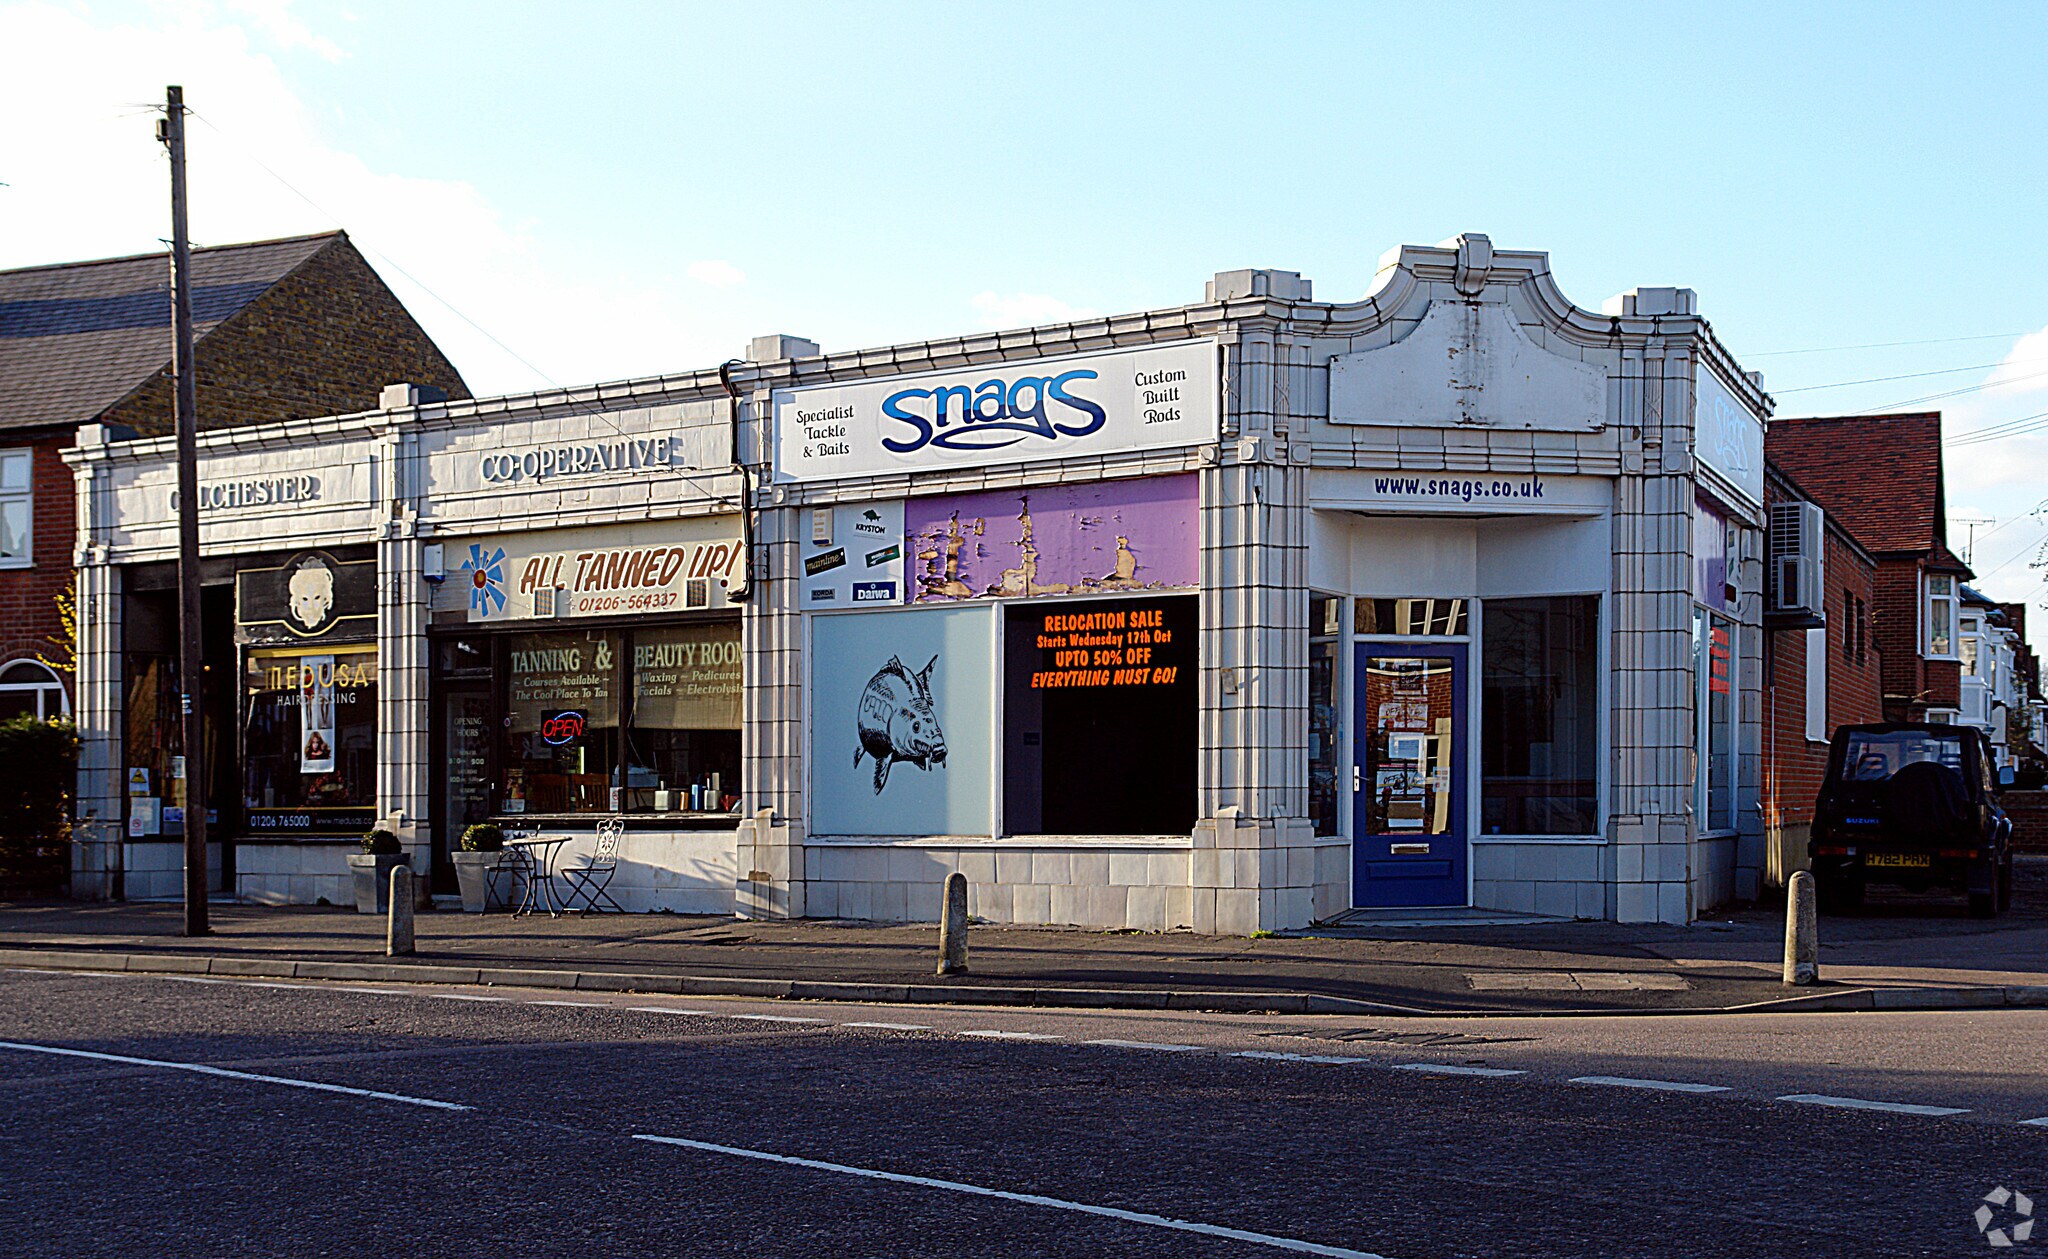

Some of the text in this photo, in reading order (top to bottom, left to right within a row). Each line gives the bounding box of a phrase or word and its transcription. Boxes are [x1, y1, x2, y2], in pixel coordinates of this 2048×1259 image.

[1135, 369, 1187, 387] Custom
[1142, 387, 1180, 405] Built
[796, 404, 854, 426] Specialist
[1143, 407, 1181, 424] Rods
[803, 424, 846, 440] Tackle
[479, 437, 672, 481] CO-OPERATIVE
[803, 442, 850, 458] & Baits
[169, 475, 313, 511] CLCHESTER
[1375, 475, 1544, 503] www.snags.co.uk
[855, 523, 886, 534] KRYSTON
[519, 538, 744, 596] ALL TANNED UP!
[579, 592, 678, 612] 01206-564337
[857, 588, 890, 600] Daiwa
[1044, 610, 1163, 632] RELOCATION SALE
[1036, 629, 1172, 648] Starts Wednesday 17th Oct
[511, 640, 613, 673] TANNING &
[635, 643, 697, 668] BEAUTY
[1055, 647, 1152, 668] UPTO 50% OFF
[265, 663, 369, 690] MEDUSA
[523, 674, 600, 687] Courses Available
[641, 670, 741, 683] Waxing Pedicures
[1031, 666, 1178, 689] EVERYTHING MUST GO!
[515, 687, 608, 700] The Cool Place To Tan
[639, 683, 743, 696] Facials Electrolysis
[277, 692, 356, 706] HAIRDRESSING
[454, 717, 482, 726] OPENING
[542, 719, 584, 737] OPEN
[456, 728, 479, 737] HOURS
[250, 815, 276, 827] 01206
[279, 815, 310, 827] 765000
